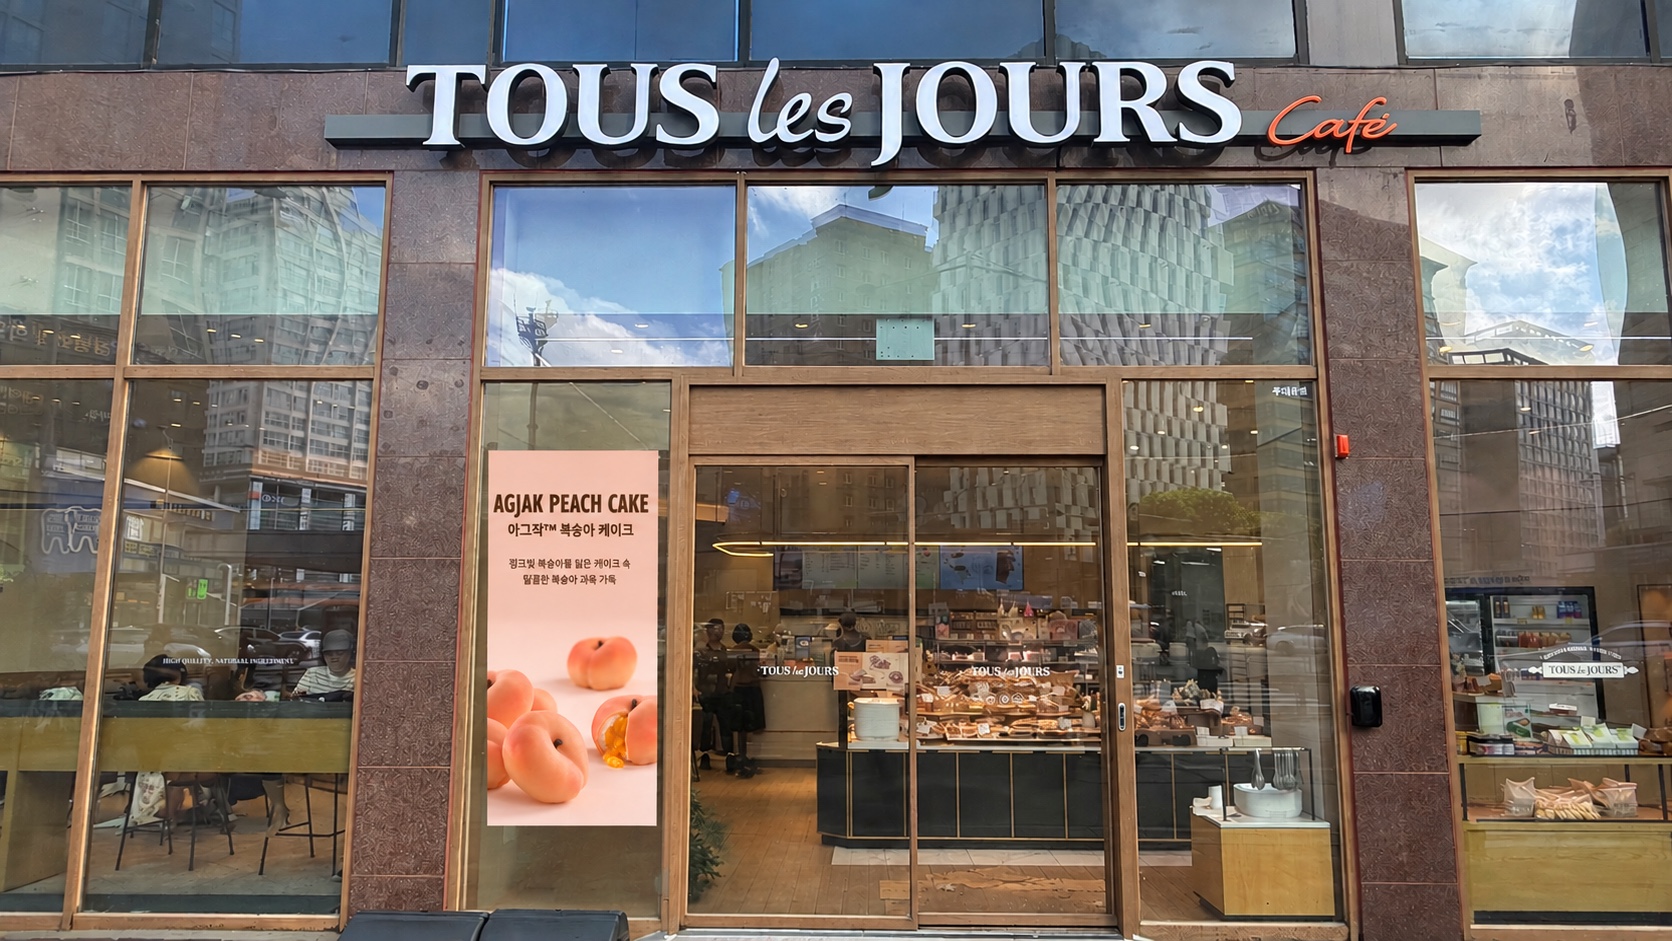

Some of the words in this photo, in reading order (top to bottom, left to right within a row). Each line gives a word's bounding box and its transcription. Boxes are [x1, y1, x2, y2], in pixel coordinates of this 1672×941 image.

[406, 62, 720, 146] TOUS
[747, 56, 854, 144] les
[871, 60, 1243, 168] JOURS
[1266, 94, 1398, 154] Café
[493, 493, 544, 518] AGJAK
[549, 493, 602, 513] PEACH
[608, 493, 649, 513] CAKE
[560, 523, 596, 537] 복숭아
[598, 523, 634, 537] 케이크
[594, 558, 621, 569] 케이크
[760, 665, 791, 676] TOUS
[803, 665, 840, 678] JOURS
[972, 666, 1001, 677] TOUS
[1015, 666, 1051, 678] JOURS
[1548, 665, 1576, 675] TOUS
